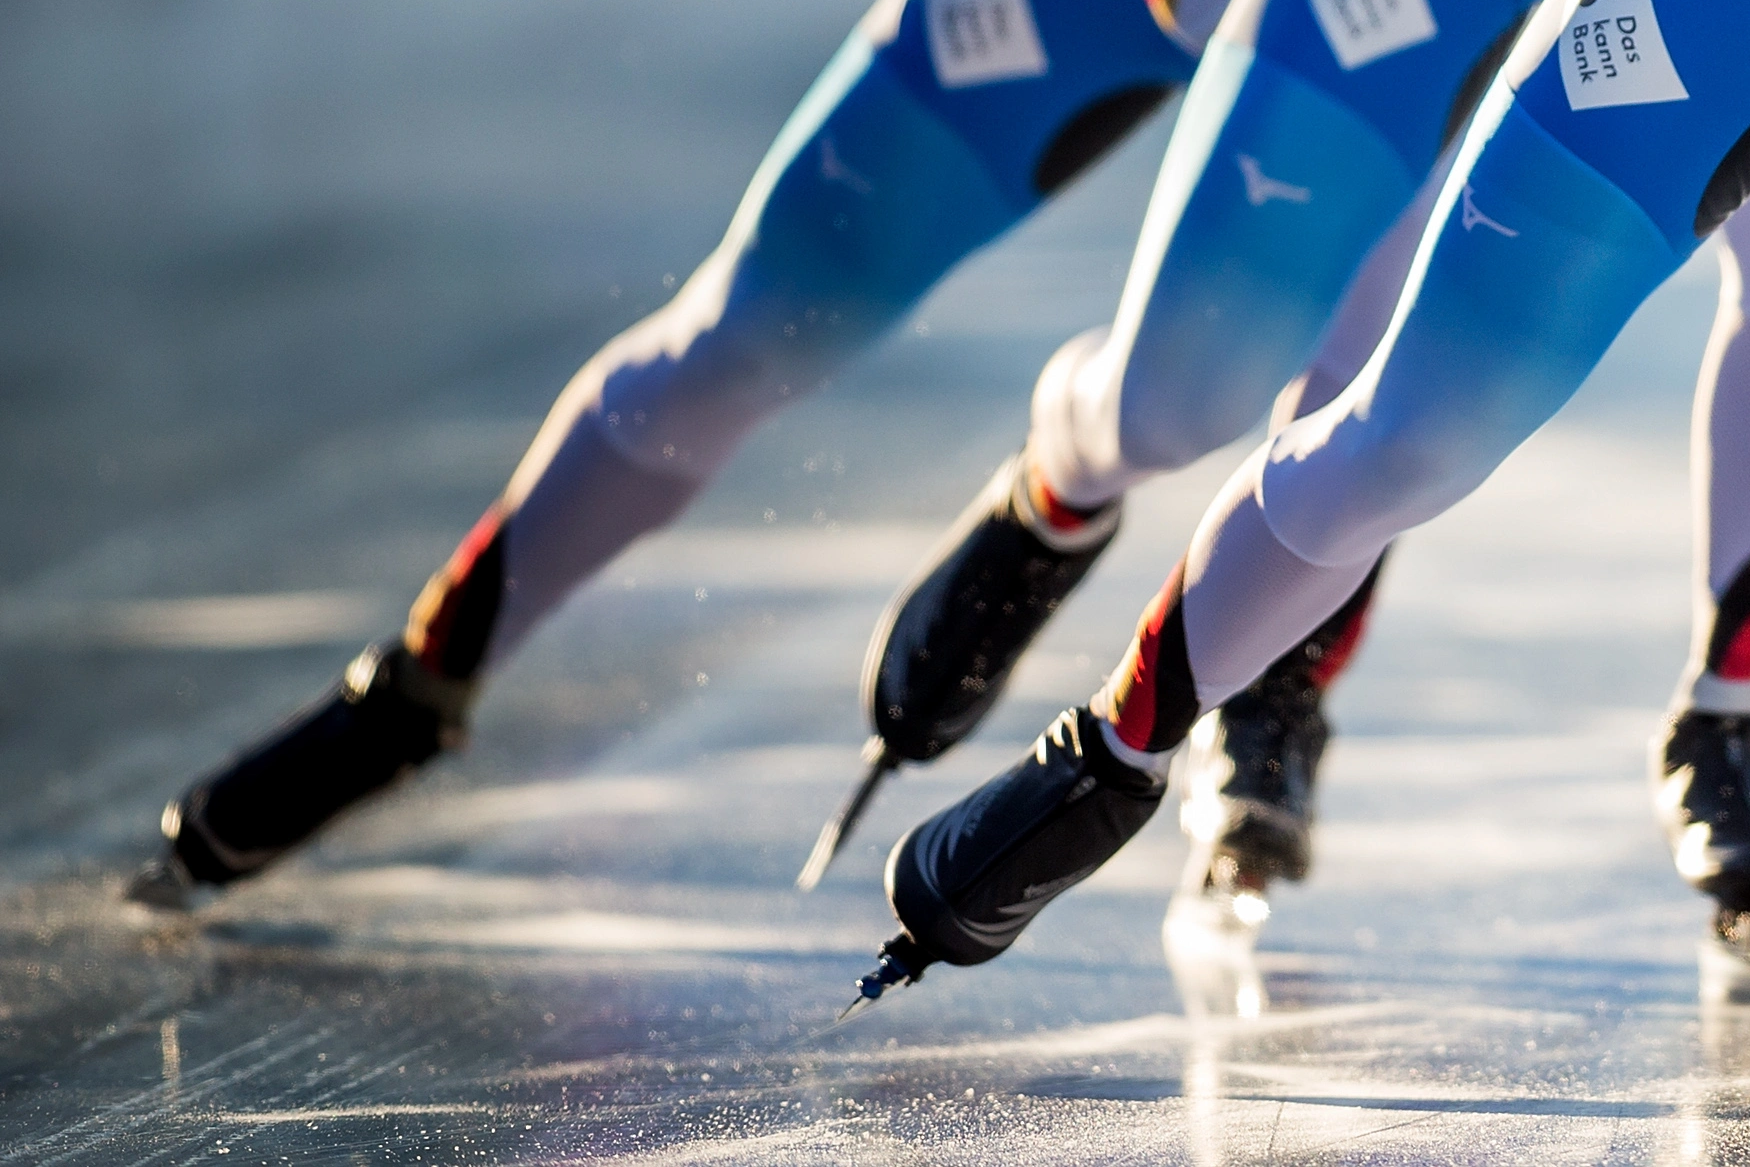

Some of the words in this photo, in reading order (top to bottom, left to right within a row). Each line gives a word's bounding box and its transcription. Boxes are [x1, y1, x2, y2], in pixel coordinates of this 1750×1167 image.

[1572, 23, 1598, 84] Bank
[1593, 18, 1618, 79] kann
[1616, 15, 1641, 64] Das
